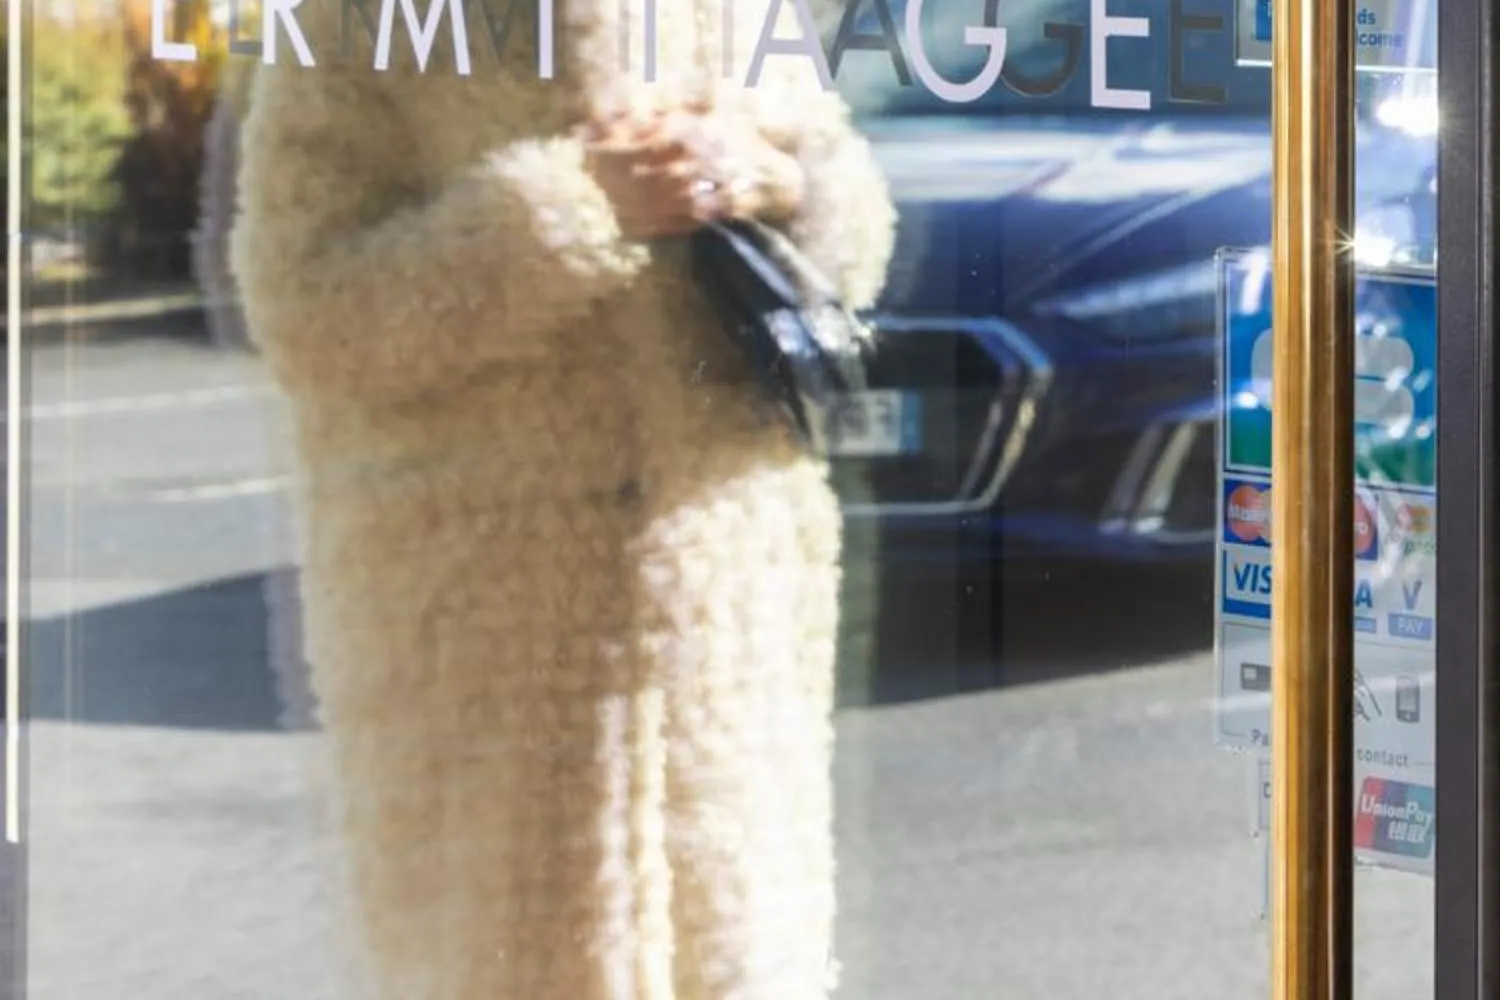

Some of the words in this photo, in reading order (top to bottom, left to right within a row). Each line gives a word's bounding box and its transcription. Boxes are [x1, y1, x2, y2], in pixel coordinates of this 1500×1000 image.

[1233, 562, 1272, 594] VIS
[1356, 748, 1409, 768] contact
[1361, 793, 1433, 832] UnionPay
